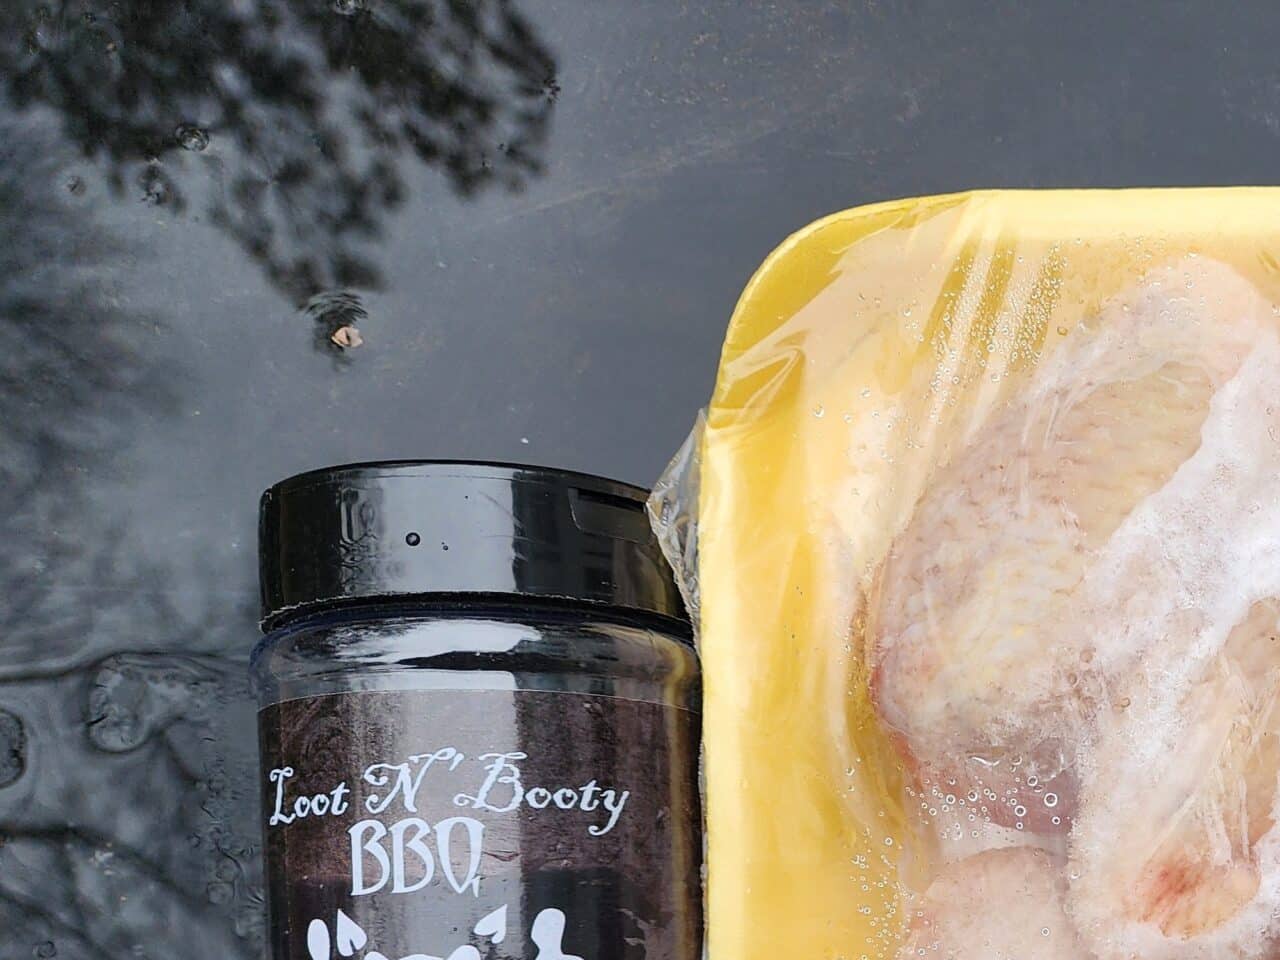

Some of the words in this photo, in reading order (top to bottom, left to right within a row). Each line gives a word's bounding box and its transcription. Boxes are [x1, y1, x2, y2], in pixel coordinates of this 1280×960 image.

[269, 766, 350, 825] Loot
[453, 752, 630, 836] Booty
[348, 817, 485, 898] BBQ
